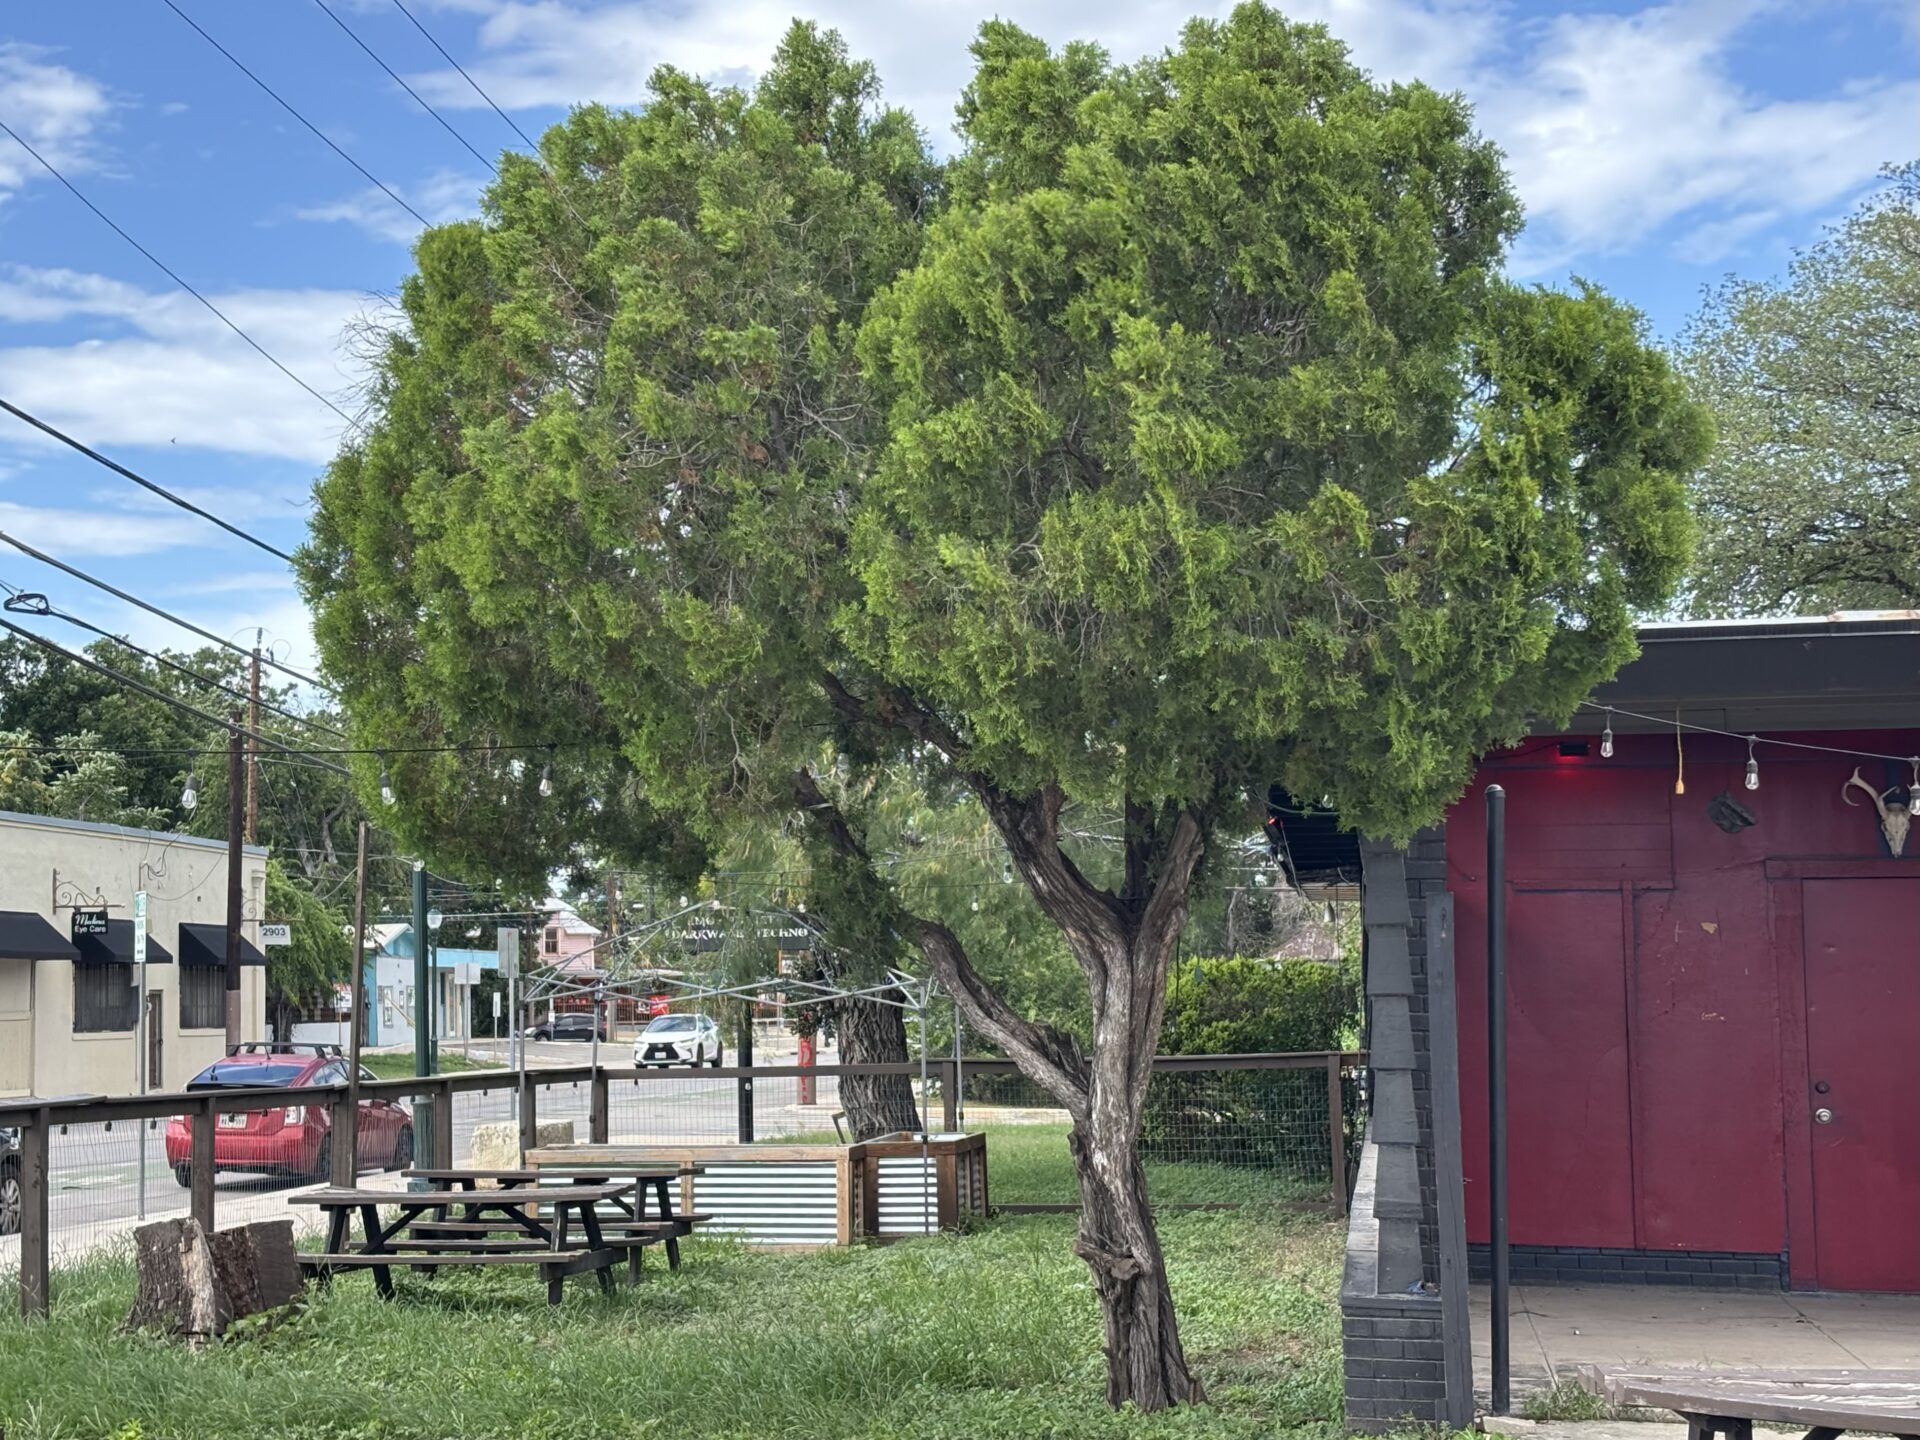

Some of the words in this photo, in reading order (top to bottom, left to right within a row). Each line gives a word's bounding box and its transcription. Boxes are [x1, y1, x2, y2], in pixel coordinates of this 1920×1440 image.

[75, 925, 88, 934] Eye
[89, 925, 106, 933] Care
[262, 927, 286, 936] 2903
[672, 928, 744, 940] DARKWAE
